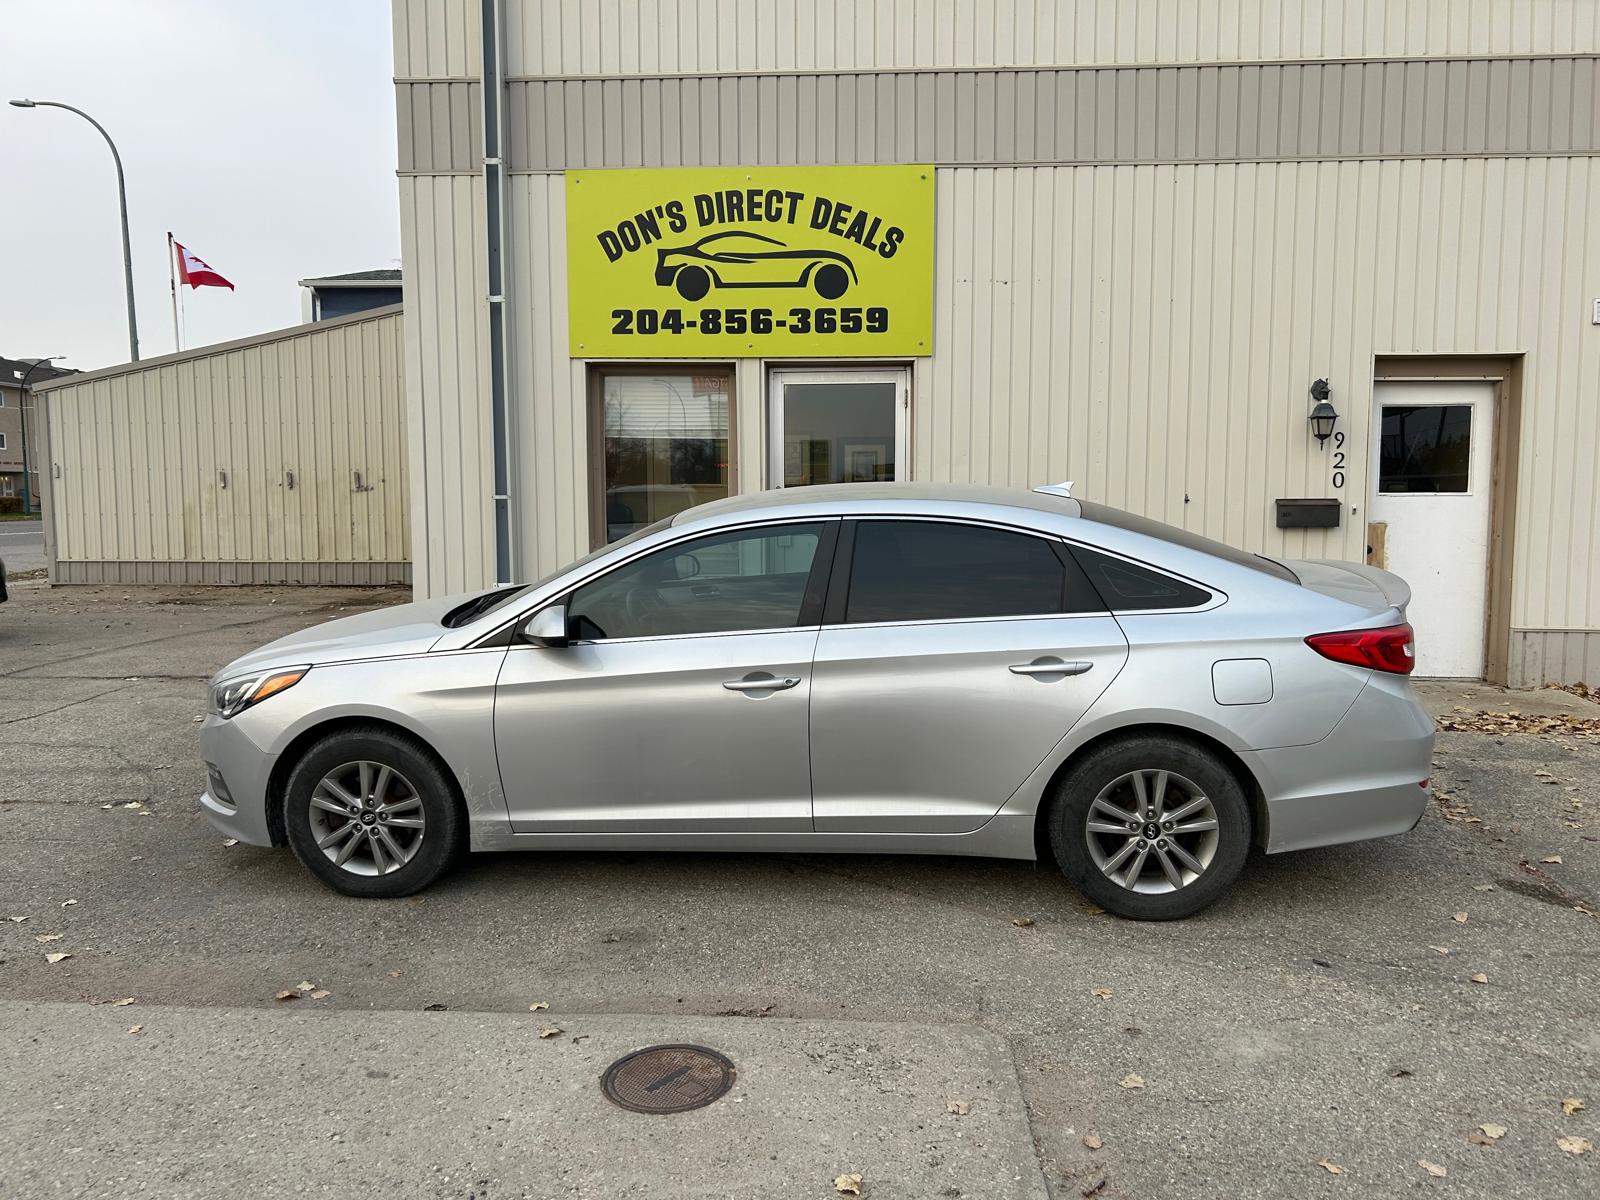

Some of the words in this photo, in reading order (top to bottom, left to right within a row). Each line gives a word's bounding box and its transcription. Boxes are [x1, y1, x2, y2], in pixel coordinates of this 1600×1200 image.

[597, 201, 687, 262] DON'S
[694, 189, 804, 227] DIRECT
[810, 197, 904, 260] DEALS
[611, 307, 889, 335] 204-856-3659
[1333, 431, 1345, 489] 920
